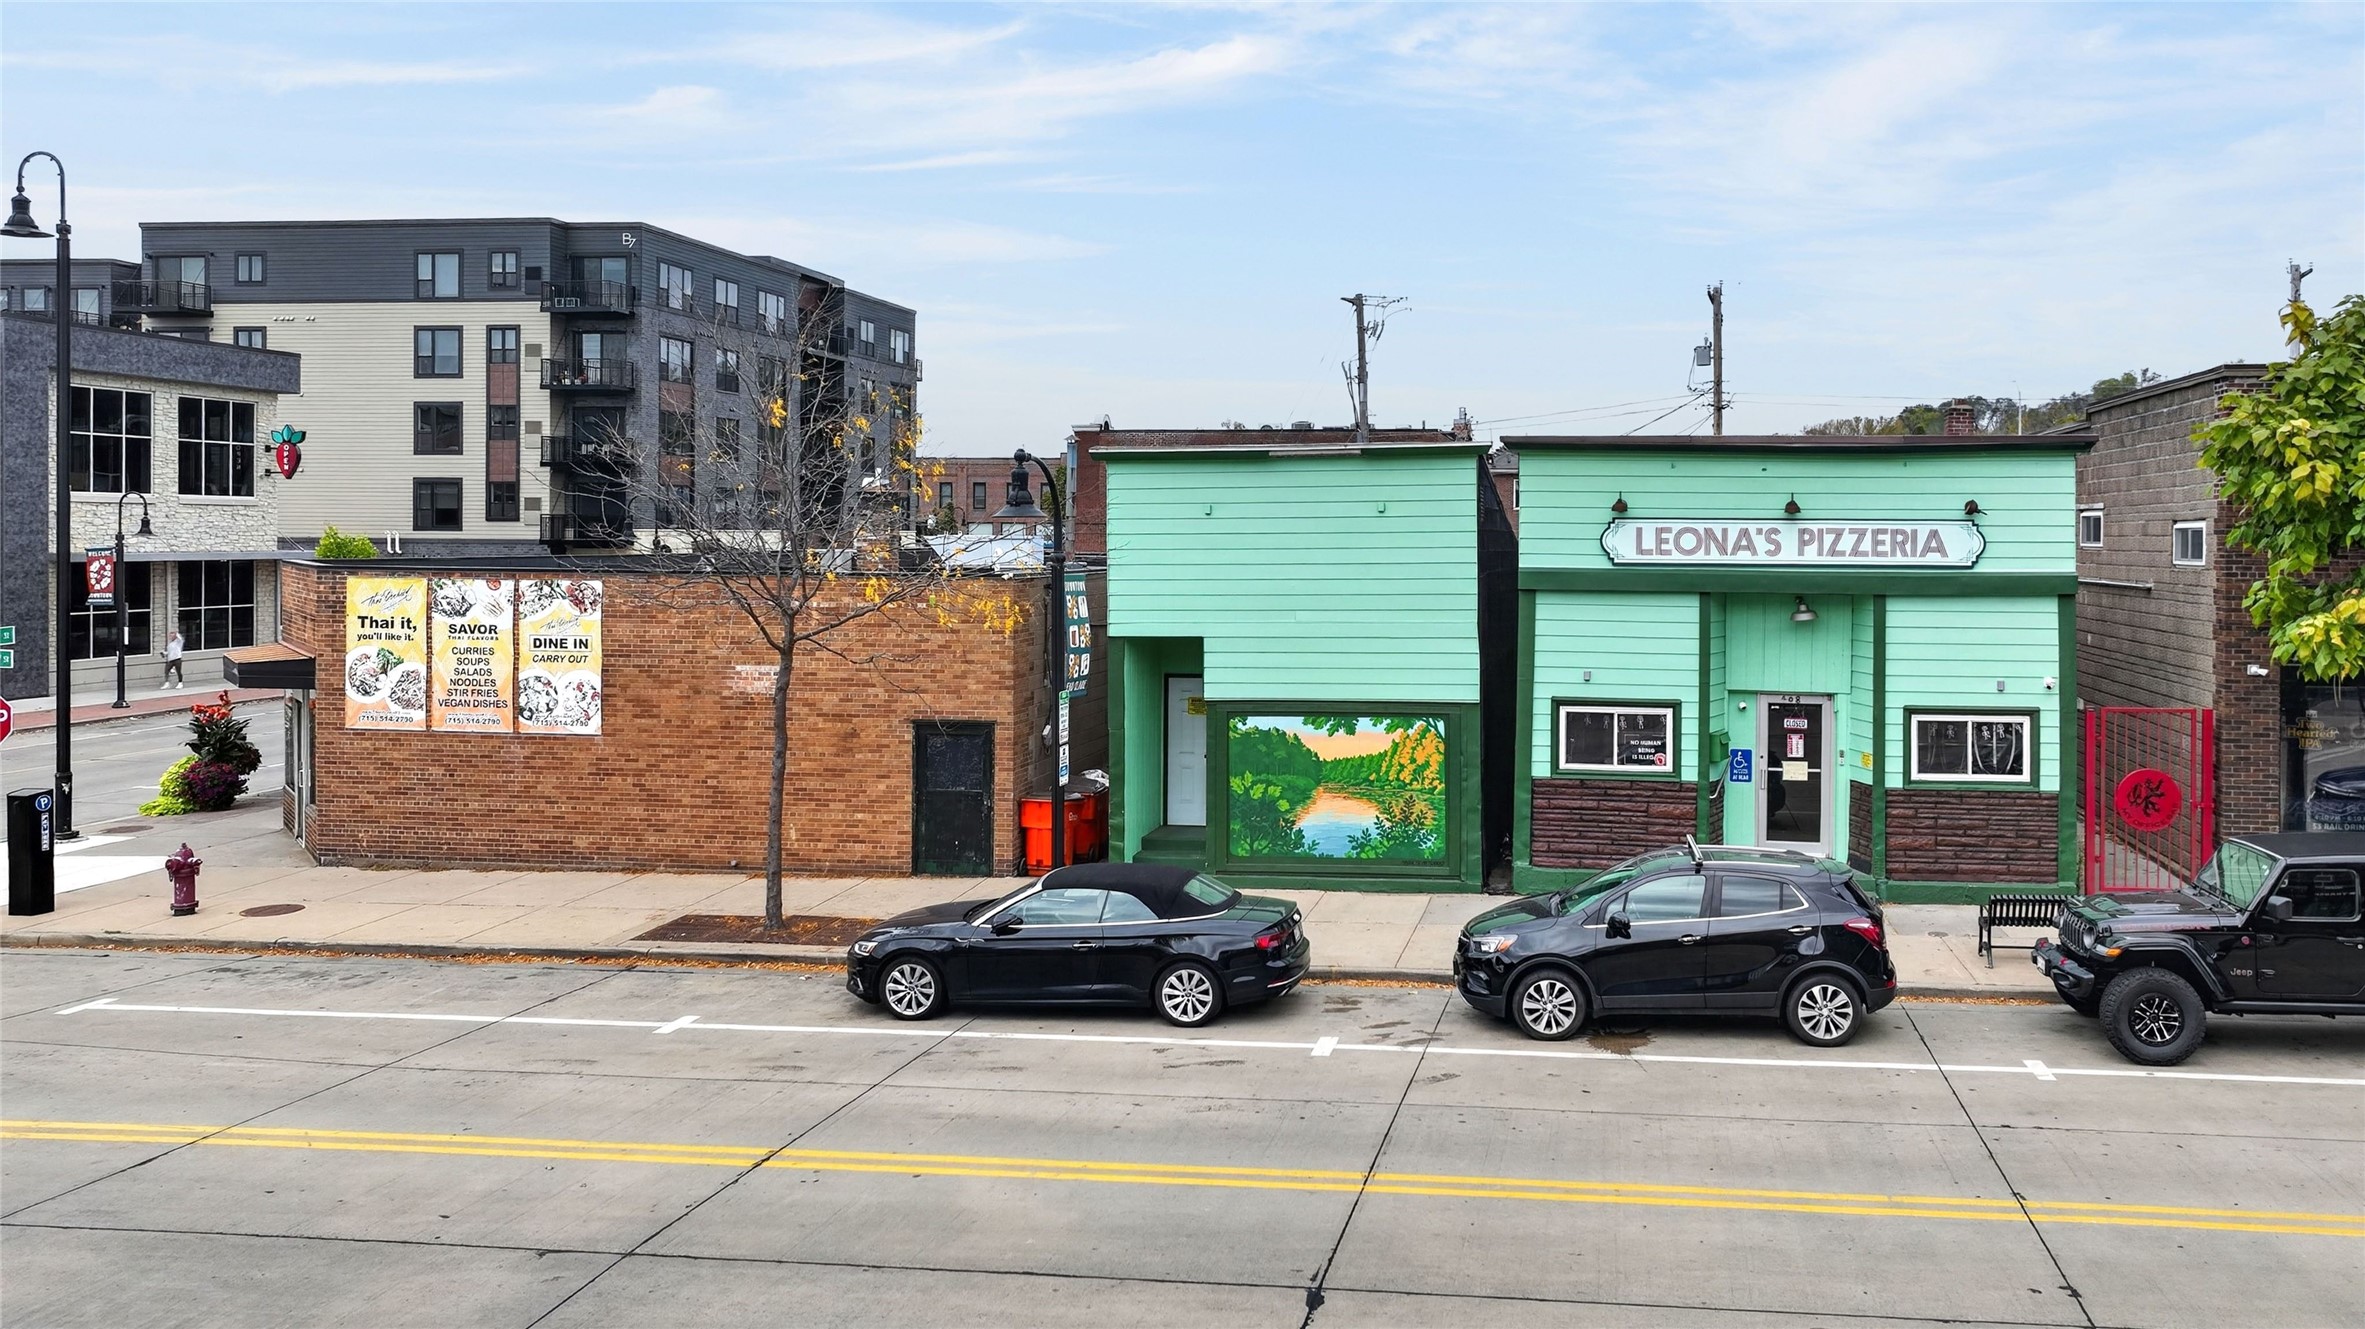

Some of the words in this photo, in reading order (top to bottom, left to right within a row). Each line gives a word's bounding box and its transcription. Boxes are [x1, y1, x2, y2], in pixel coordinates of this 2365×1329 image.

[1635, 527, 1782, 557] LEONA'S
[1797, 527, 1949, 558] PIZZERIA
[357, 616, 395, 629] Thai
[401, 616, 417, 632] it,
[448, 624, 498, 635] SAVOR
[357, 632, 383, 641] you'll
[385, 632, 402, 641] like
[404, 633, 414, 641] it.
[533, 637, 568, 649] DINE
[573, 638, 589, 649] IN
[451, 646, 495, 656] CURRIES
[456, 657, 490, 666] SOUPS
[532, 654, 566, 664] CARRY
[568, 654, 588, 664] OUT
[453, 667, 493, 677] SALADS
[449, 678, 497, 688] NOODLES
[446, 688, 469, 697] STIR
[471, 689, 499, 698] FRIES
[438, 698, 471, 708] VEGAN
[472, 699, 508, 709] DISHES
[358, 715, 377, 723] (715)
[444, 717, 464, 725] (715)
[1786, 720, 1806, 728] CLOSED
[2300, 738, 2321, 748] IPA
[2230, 967, 2253, 976] Jeep
